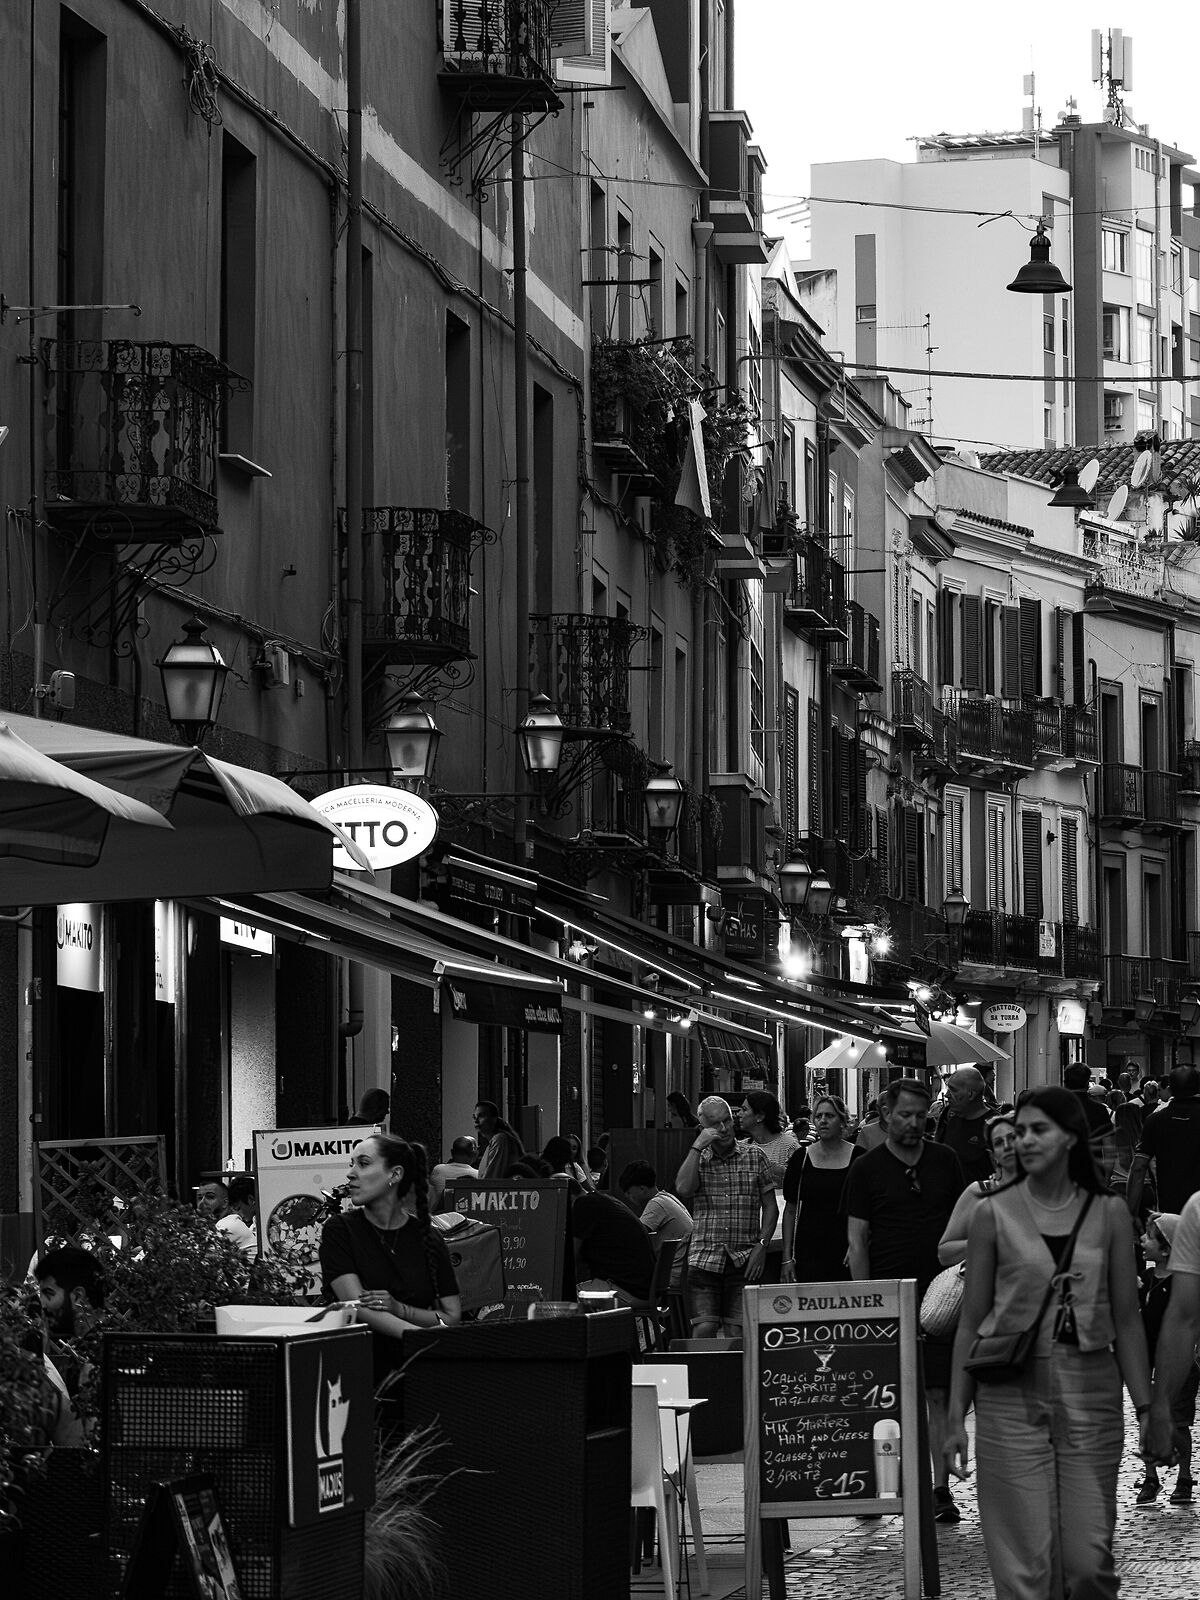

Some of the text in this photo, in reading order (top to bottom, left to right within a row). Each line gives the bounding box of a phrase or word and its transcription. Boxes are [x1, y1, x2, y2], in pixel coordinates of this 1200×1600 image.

[336, 798, 382, 809] MACELLERIA
[384, 800, 421, 820] MODERNA
[332, 820, 408, 848] TTO
[989, 1004, 1021, 1013] TRATTORIA
[470, 1190, 541, 1211] MAKITO
[797, 1293, 885, 1311] PAULANER
[814, 1374, 826, 1383] DI
[780, 1383, 790, 1395] 2
[793, 1382, 837, 1394] SPRITZ
[768, 1394, 837, 1408] TAGLIERE
[764, 1422, 790, 1437] MIX
[778, 1428, 871, 1446] HAM AND CHEESE
